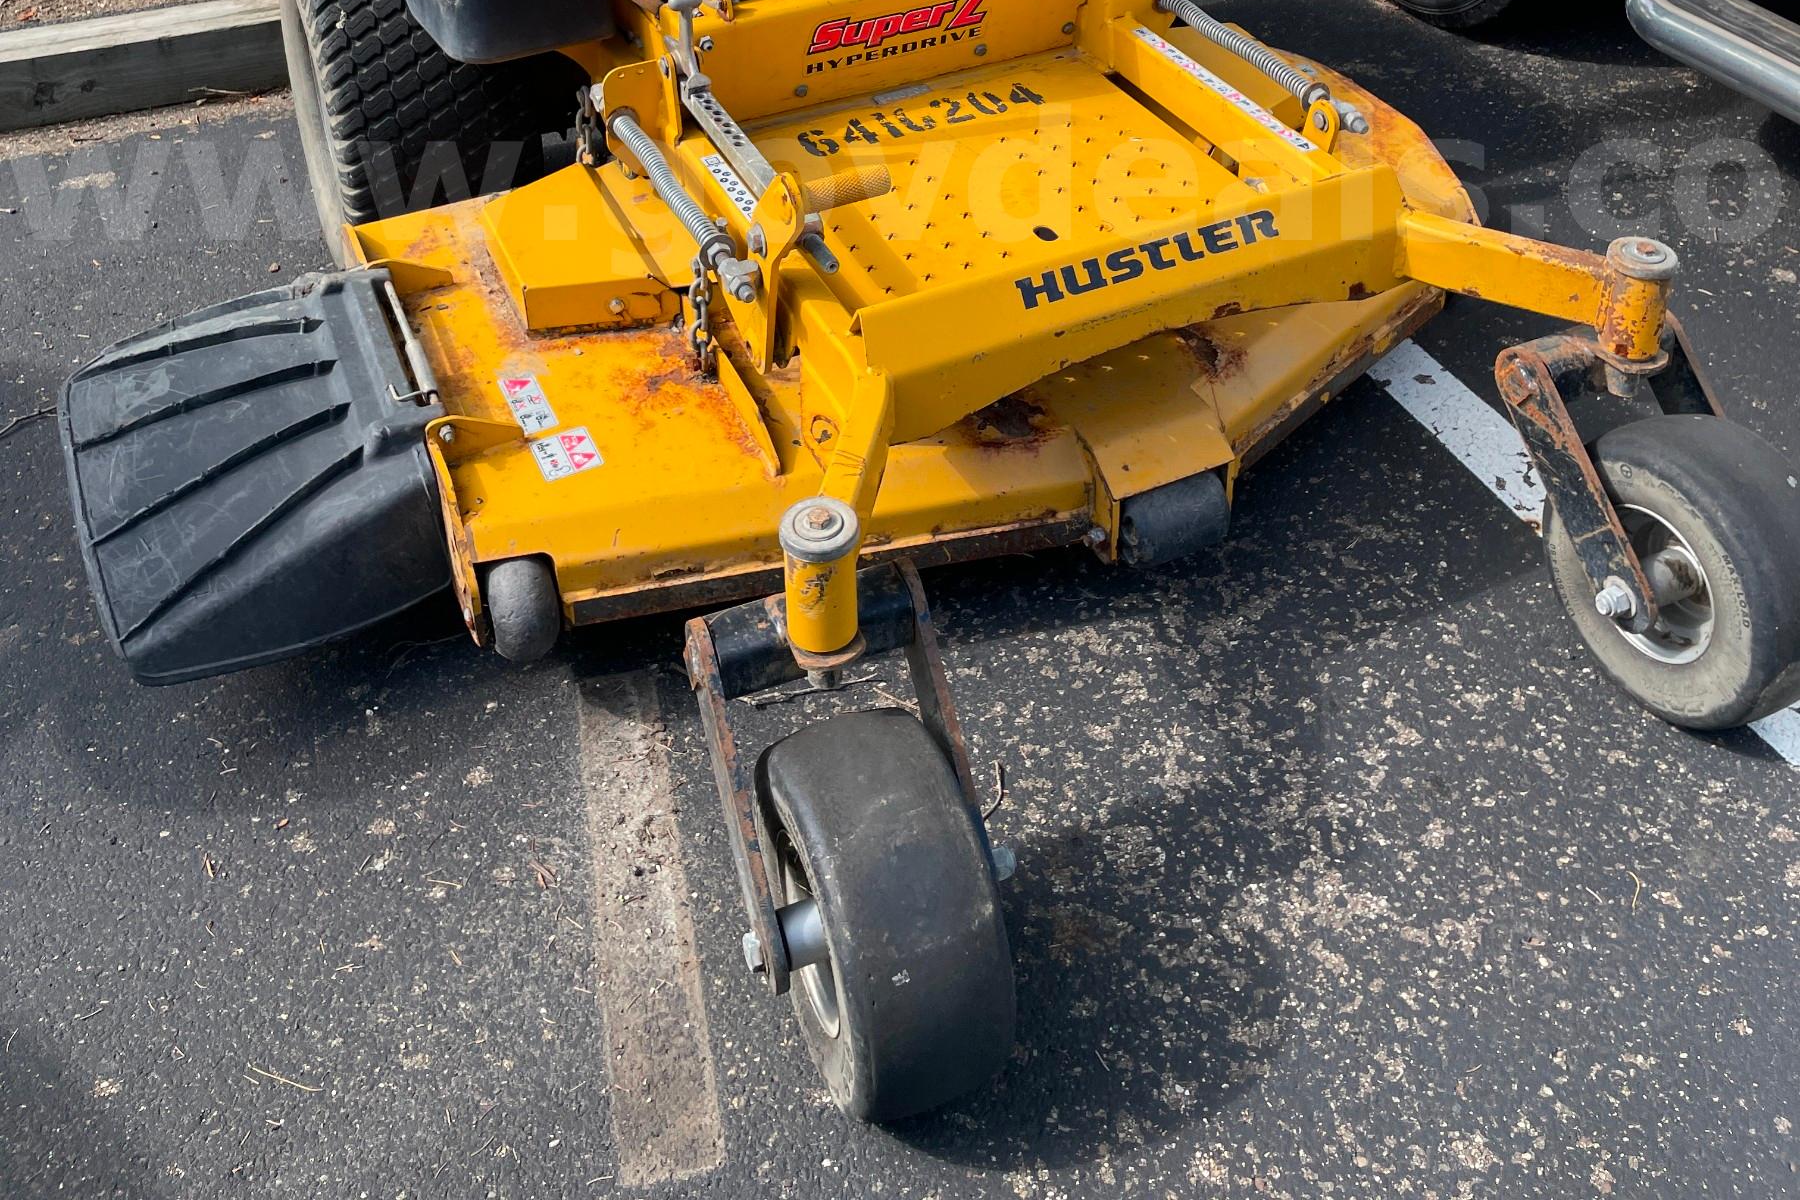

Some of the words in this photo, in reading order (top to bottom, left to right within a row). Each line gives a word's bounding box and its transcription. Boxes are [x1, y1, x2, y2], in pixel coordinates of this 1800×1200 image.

[806, 26, 982, 75] HYPERDRIVE
[1014, 208, 1280, 310] HUSTLER
[1736, 592, 1750, 629] LOAD
